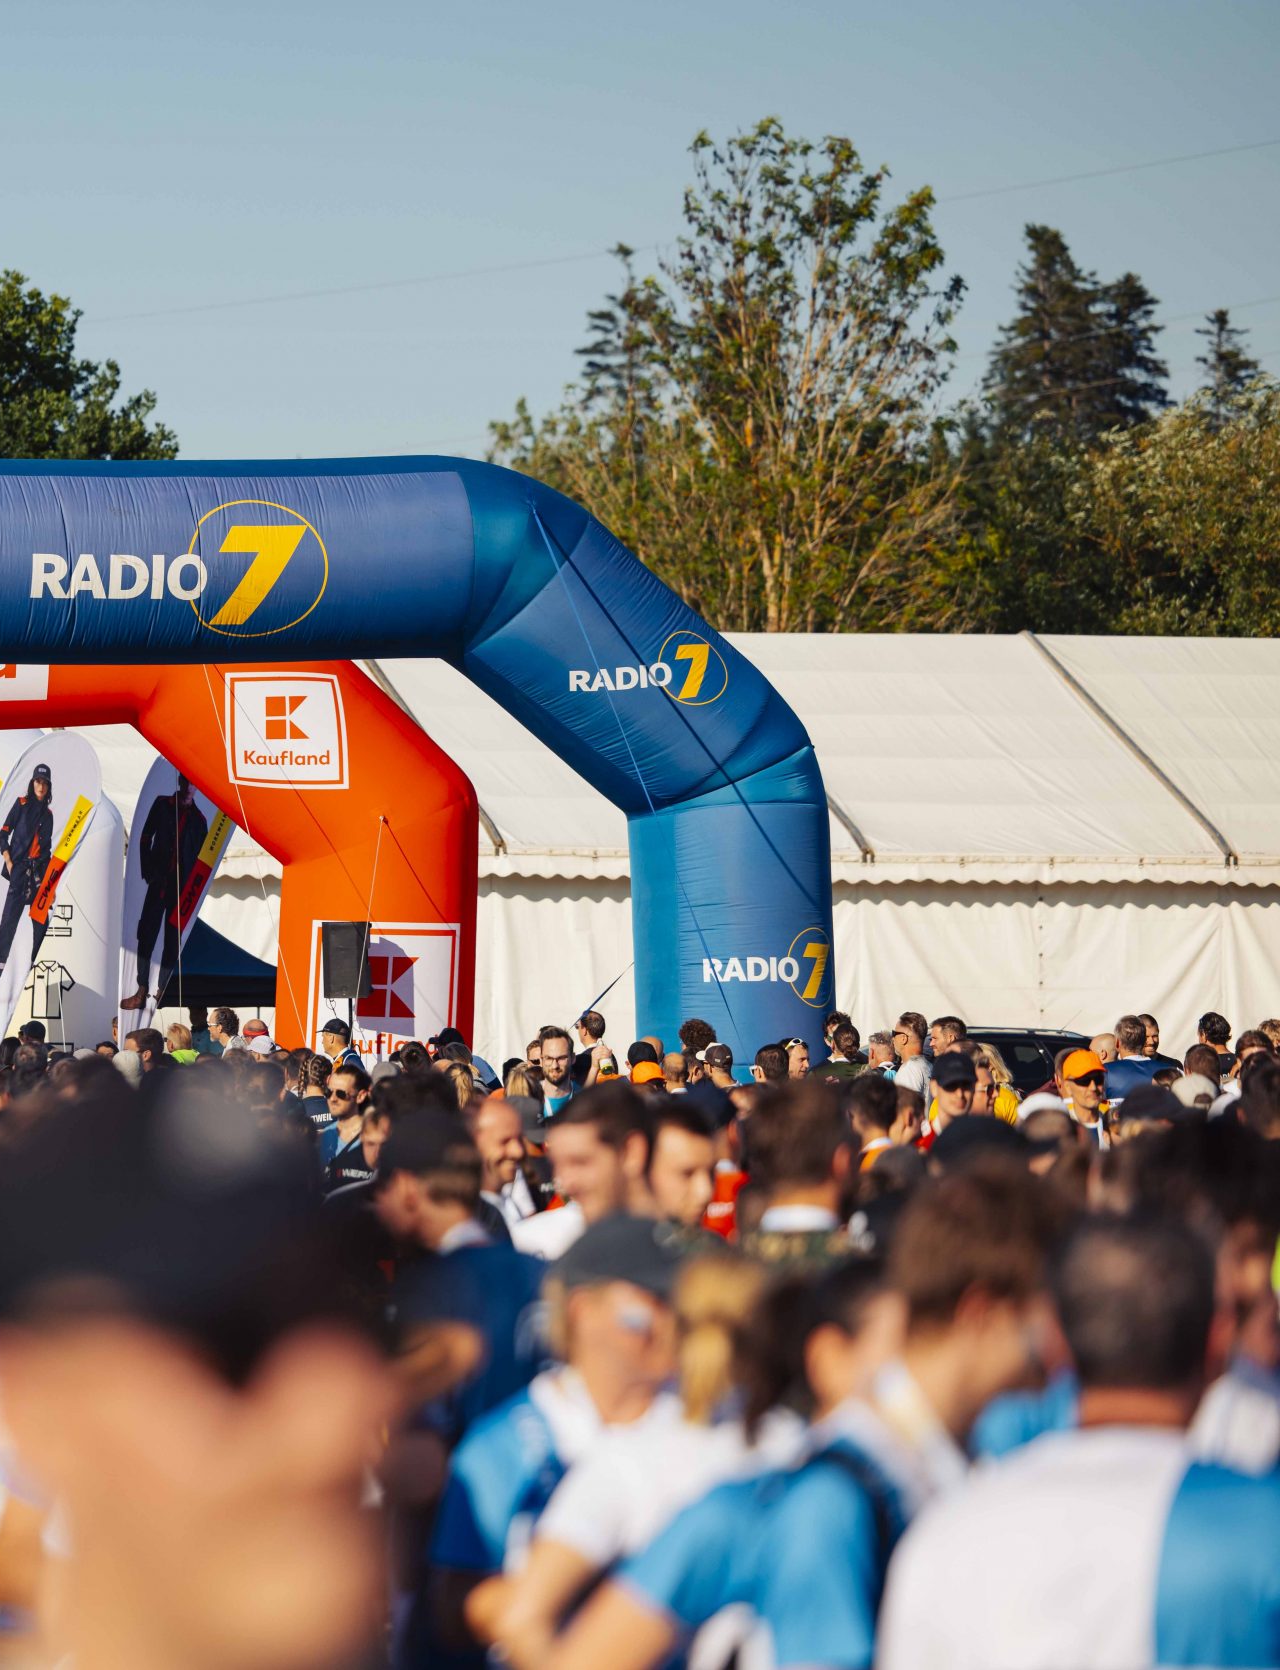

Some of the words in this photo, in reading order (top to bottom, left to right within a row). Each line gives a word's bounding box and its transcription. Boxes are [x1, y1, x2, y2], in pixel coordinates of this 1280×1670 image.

[30, 553, 208, 600] RADIO
[208, 524, 308, 625] 7
[569, 662, 672, 692] RADIO
[674, 643, 710, 700] 7
[243, 750, 330, 766] Kaufland
[37, 868, 59, 910] CWS
[702, 957, 800, 983] RADIO
[801, 942, 830, 999] 7
